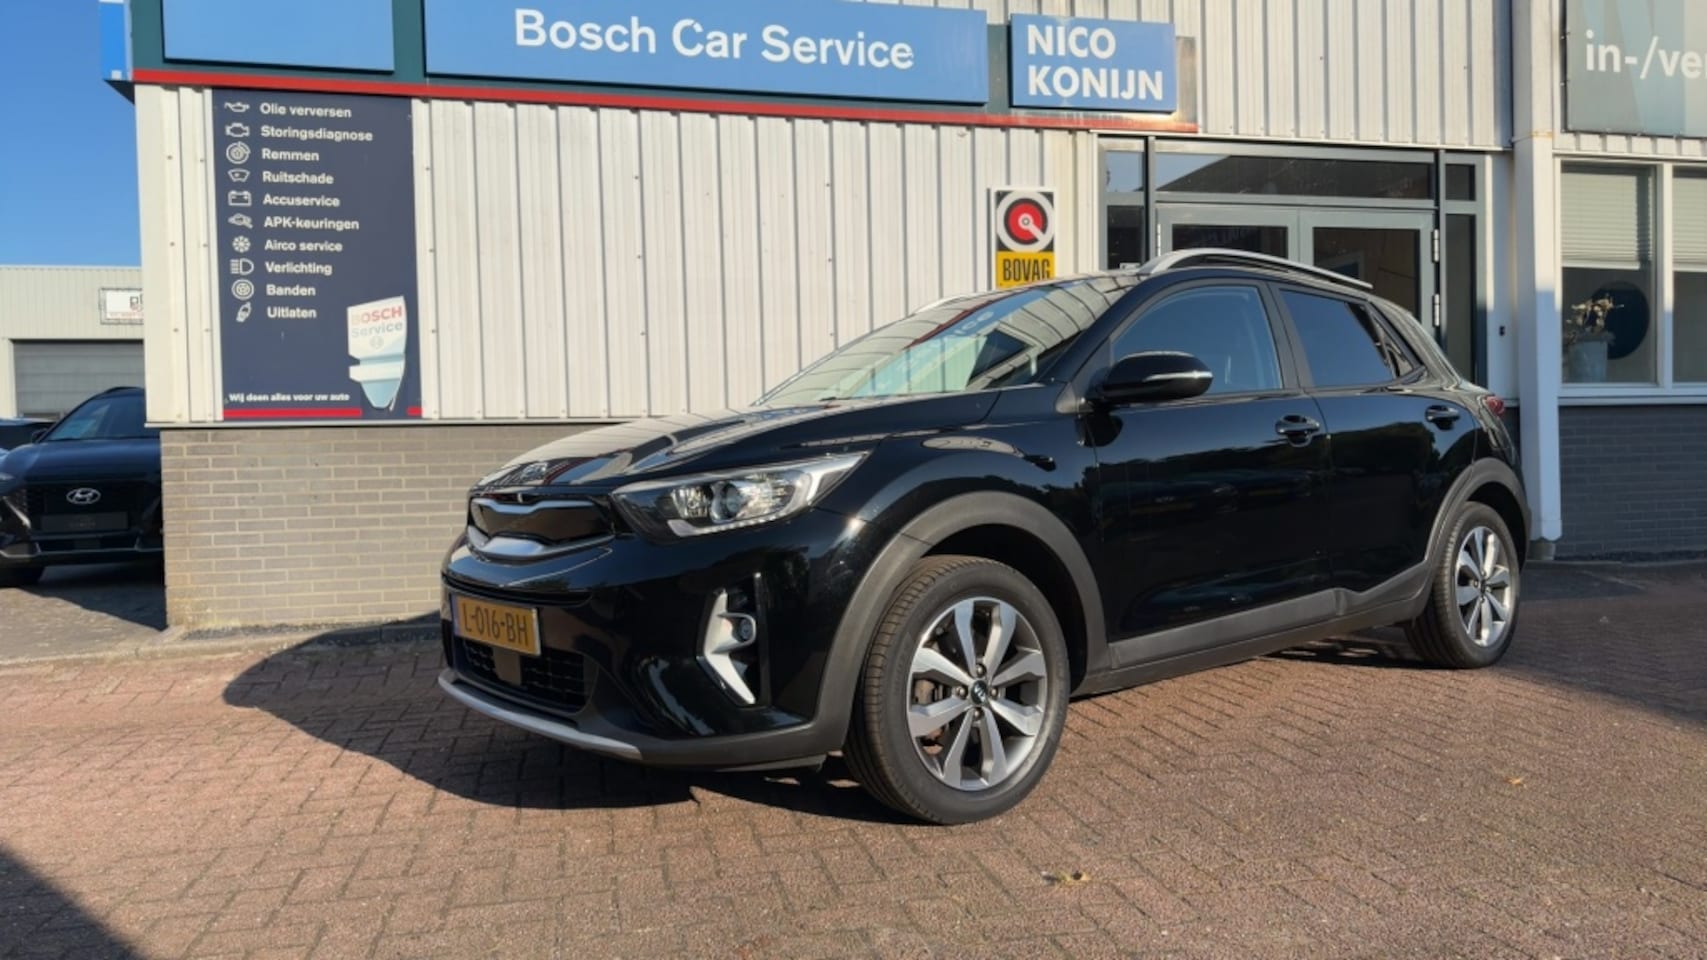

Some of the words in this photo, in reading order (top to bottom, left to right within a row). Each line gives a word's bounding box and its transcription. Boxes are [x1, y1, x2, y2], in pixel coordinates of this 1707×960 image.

[515, 7, 657, 54] Bosch
[672, 18, 748, 59] Car
[761, 24, 914, 70] Service
[1027, 25, 1117, 59] NICO
[1586, 29, 1707, 80] in-/ve
[1027, 65, 1164, 101] KONIJN
[260, 102, 287, 115] Olie
[289, 106, 352, 118] verversen
[260, 125, 374, 142] Storingsdiagnose
[262, 147, 320, 161] Remmen
[262, 170, 335, 184] Ruitschade
[263, 193, 341, 207] Accuservice
[264, 216, 360, 232] APK-keuringen
[264, 239, 297, 251] Airco
[299, 241, 343, 252] service
[265, 261, 333, 276] Verlichting
[1003, 258, 1050, 281] BOVAG
[266, 284, 316, 296] Banden
[267, 306, 317, 319] Uitlaten
[351, 321, 404, 338] Service
[229, 393, 245, 403] Wij
[270, 393, 291, 402] alles
[293, 393, 314, 402] voor
[314, 394, 329, 402] uw
[330, 393, 350, 402] auto
[463, 603, 529, 646] L-016-BH
